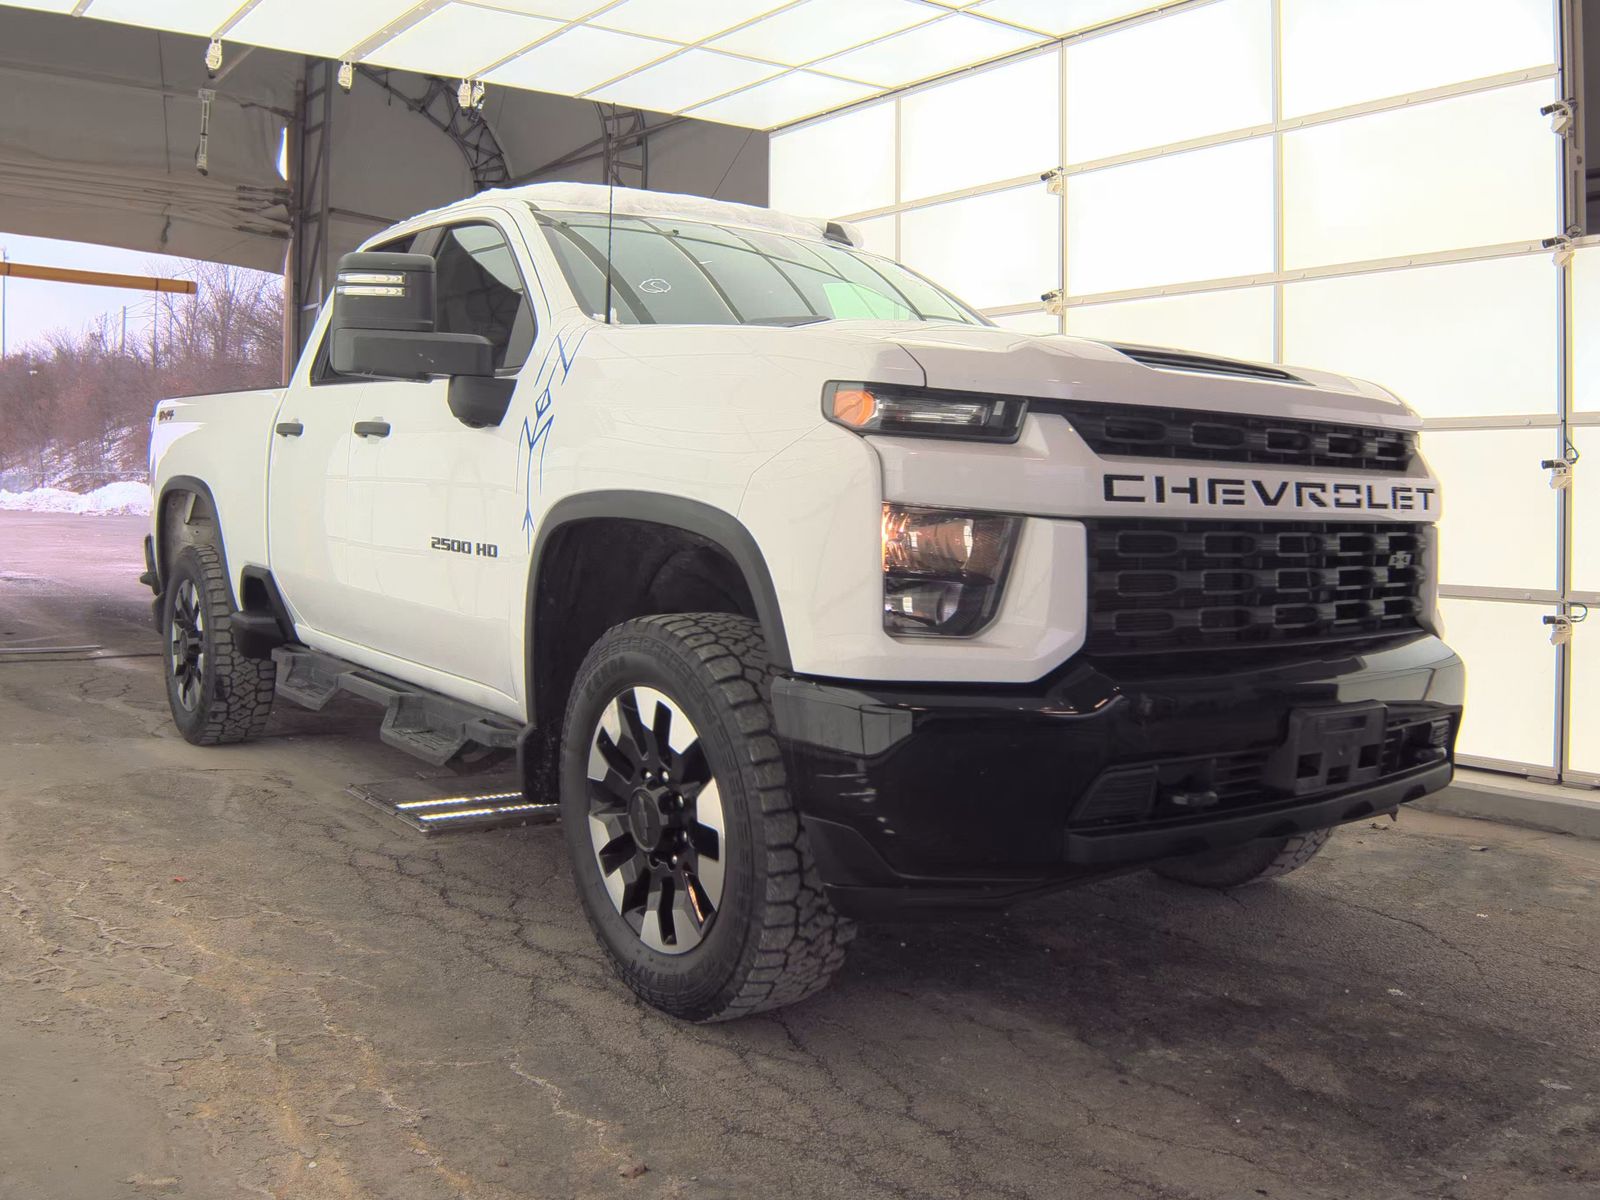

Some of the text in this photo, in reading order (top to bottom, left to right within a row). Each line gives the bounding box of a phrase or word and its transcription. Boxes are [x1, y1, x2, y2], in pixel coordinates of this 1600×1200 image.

[1103, 474, 1436, 511] CHEVROLET
[431, 536, 498, 558] 2500 HD
